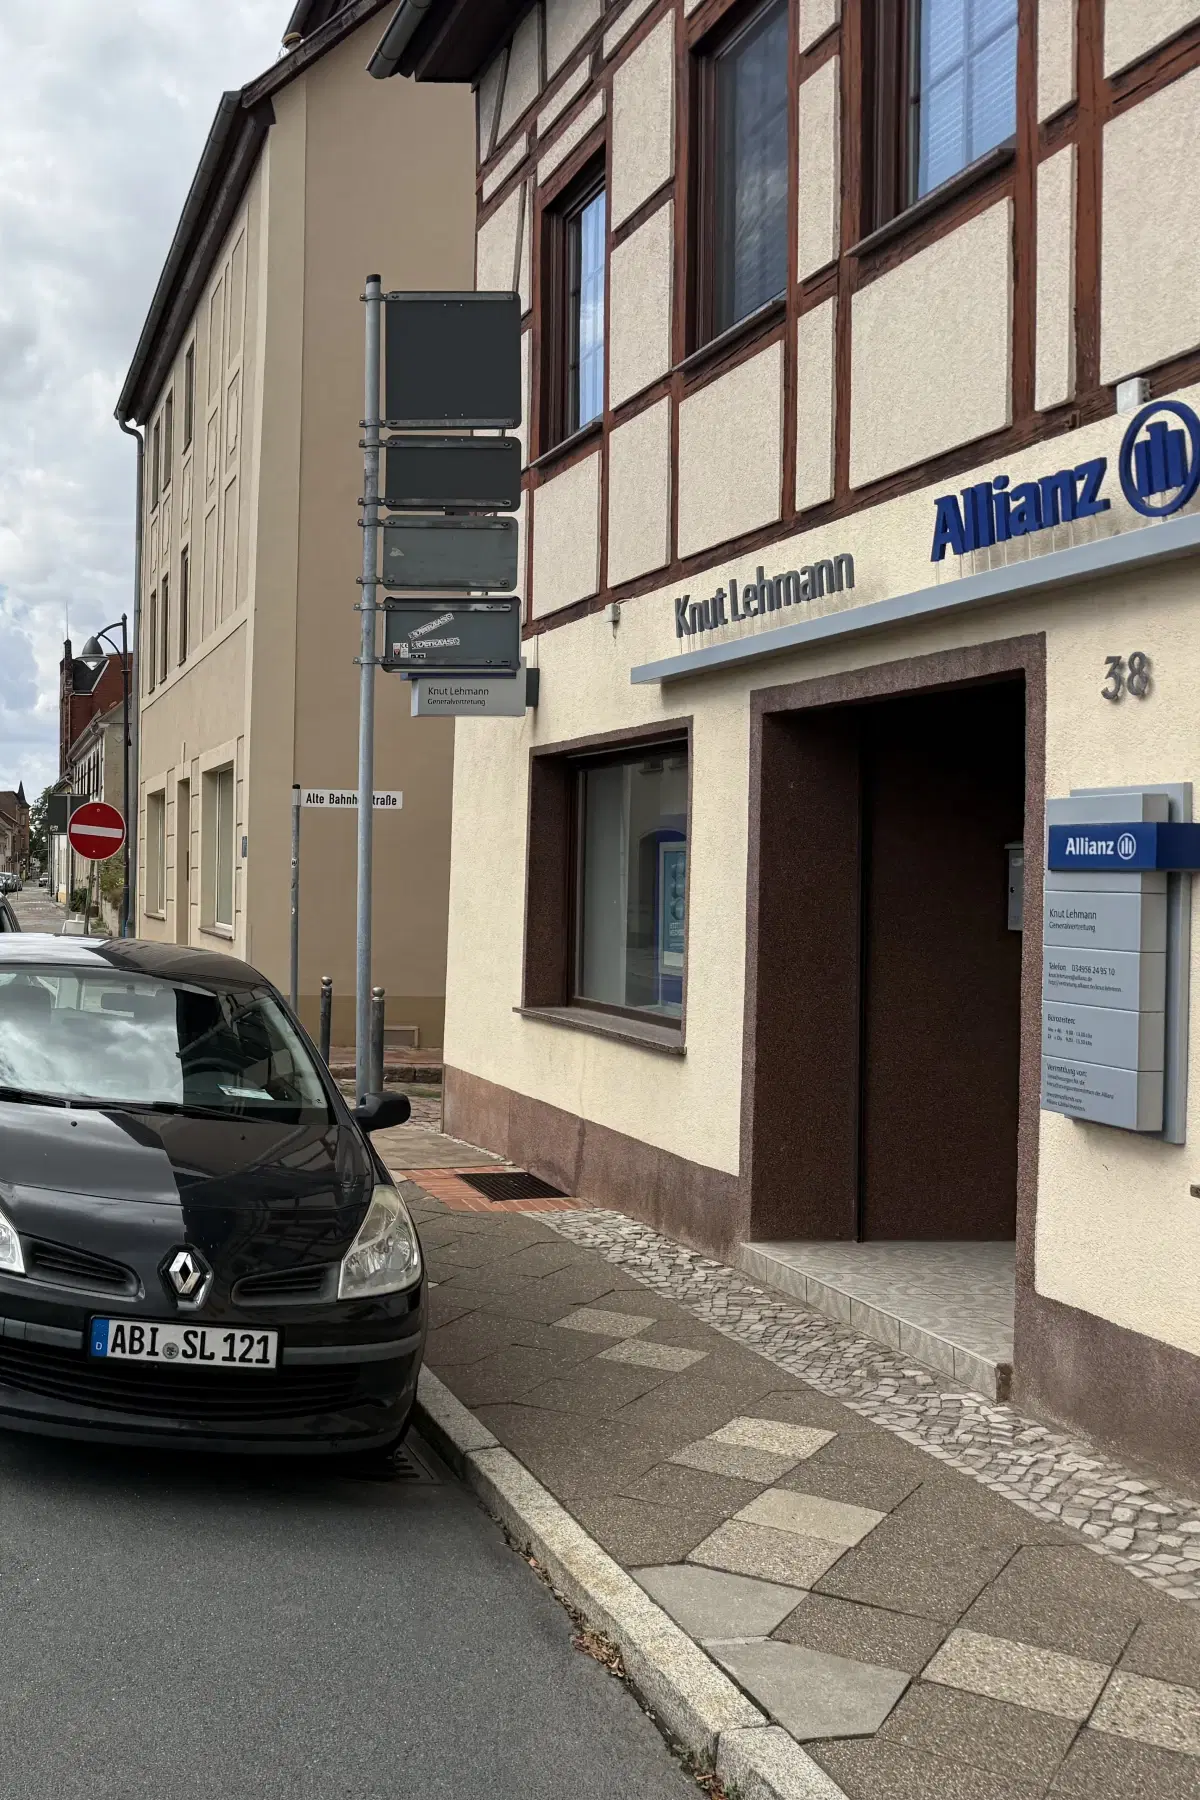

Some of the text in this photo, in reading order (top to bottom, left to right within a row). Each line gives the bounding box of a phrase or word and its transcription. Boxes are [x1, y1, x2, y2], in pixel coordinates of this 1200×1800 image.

[930, 456, 1112, 562] Allianz
[674, 552, 855, 638] Knut Lehmann
[1101, 651, 1150, 700] 38
[428, 687, 489, 696] Knut Lehmann
[427, 698, 486, 706] Generalvertretung
[305, 793, 397, 806] Alte Bahnhtraße
[1065, 837, 1114, 855] Allianz
[1049, 908, 1097, 920] Knut Lehmann
[1048, 921, 1096, 934] Generalvertretung
[1048, 962, 1067, 971] Telefon
[1092, 966, 1100, 975] 24
[1100, 967, 1107, 975] 95
[95, 1341, 103, 1351] D
[110, 1324, 271, 1365] ABI SL 121
